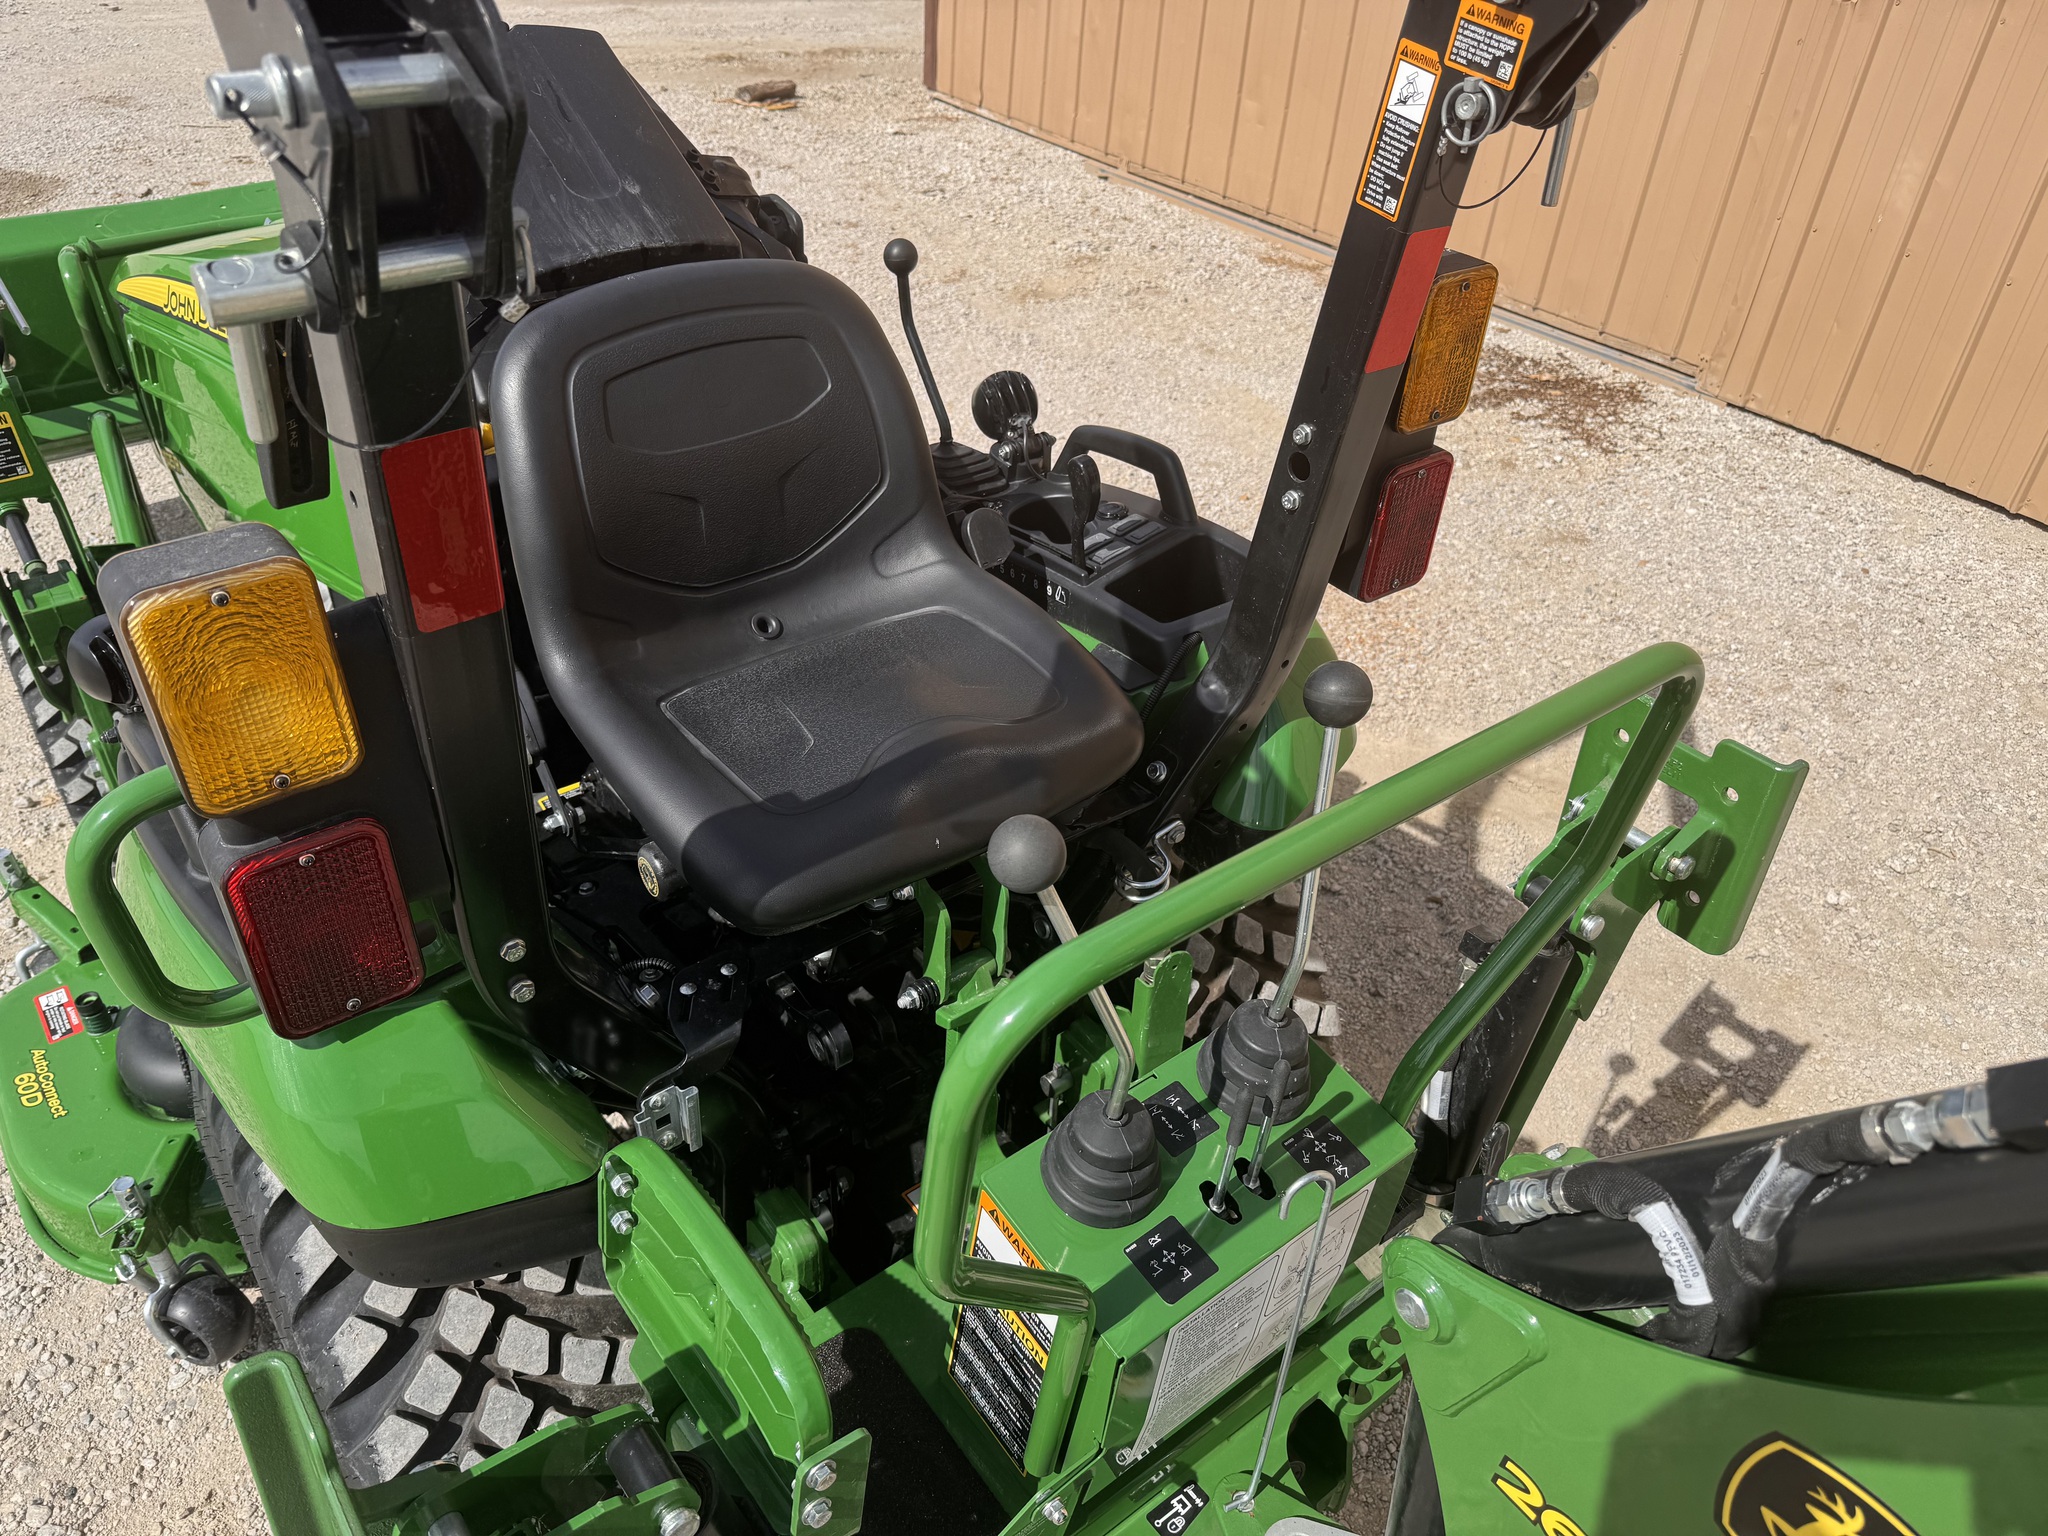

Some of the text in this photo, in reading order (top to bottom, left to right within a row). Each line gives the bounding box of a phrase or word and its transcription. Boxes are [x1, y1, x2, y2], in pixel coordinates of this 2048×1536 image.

[1475, 7, 1526, 34] WARNING
[1463, 30, 1484, 41] attached
[1499, 42, 1514, 53] ROPS
[1468, 24, 1486, 35] canopy
[1493, 33, 1517, 46] sunshade
[1408, 48, 1440, 71] WARNING
[1454, 40, 1468, 50] MUST
[1476, 49, 1493, 60] limited
[1480, 58, 1490, 68] kg)
[1487, 46, 1505, 58] weight
[164, 285, 196, 321] JOHN
[1021, 574, 1026, 582] 7
[1034, 579, 1039, 589] 8
[1046, 585, 1052, 596] 9
[14, 1072, 44, 1108] 60D
[30, 1049, 68, 1119] AutoConnect
[1002, 1221, 1040, 1270] WARN
[1673, 1231, 1700, 1278] 01/12/2023
[1674, 1259, 1692, 1289] 017234
[997, 1313, 1013, 1335] AVOID
[1178, 1296, 1226, 1334] INSTALLATION
[1003, 1309, 1044, 1364] UTION
